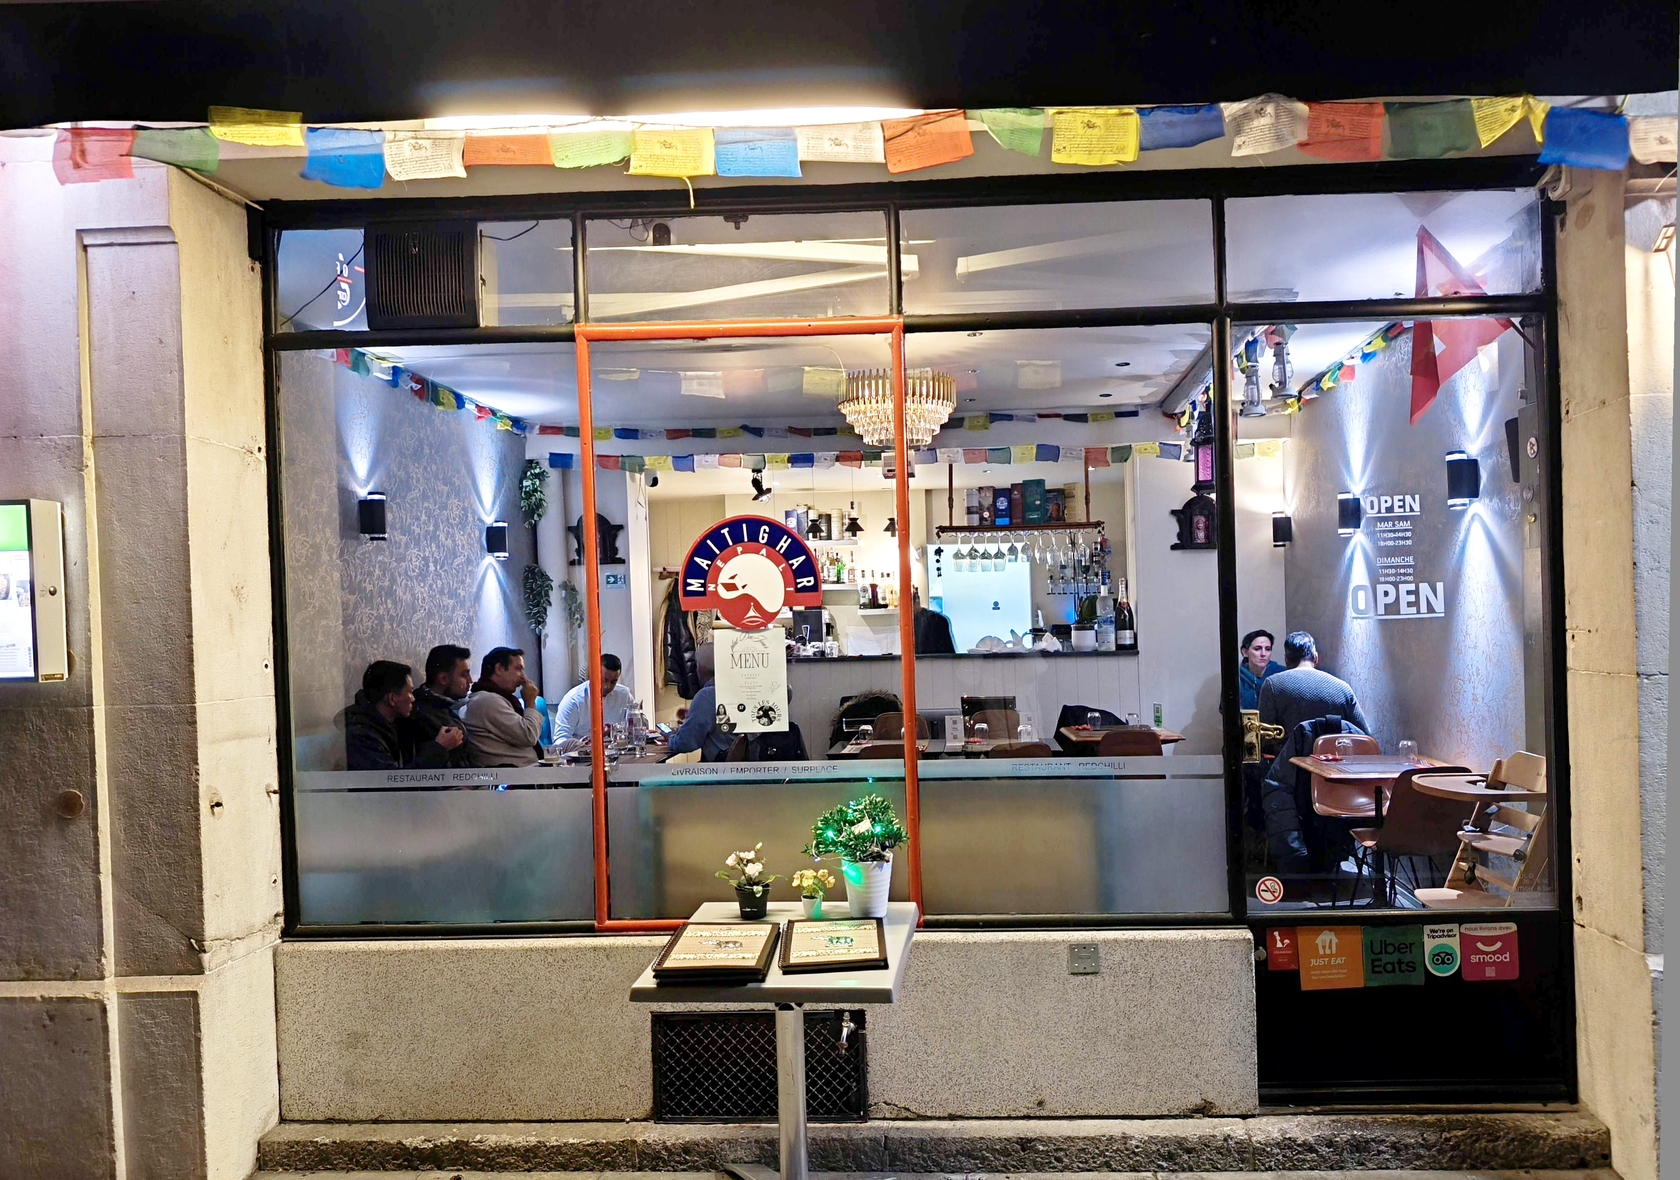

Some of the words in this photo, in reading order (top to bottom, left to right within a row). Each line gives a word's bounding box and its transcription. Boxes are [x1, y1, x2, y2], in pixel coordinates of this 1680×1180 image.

[1366, 494, 1420, 514] OPEN
[1377, 521, 1393, 529] MAR
[1394, 520, 1411, 528] SAM
[685, 523, 815, 592] MAITIGHAR
[1376, 556, 1414, 564] DIMANCHE
[707, 546, 794, 591] NEPALI
[1351, 581, 1445, 616] OPEN
[730, 652, 770, 670] MENU
[771, 702, 782, 722] JOURS
[671, 767, 719, 776] LIVRAISON
[730, 766, 779, 775] EMPORTER
[791, 765, 838, 774] SURPLACE
[1011, 762, 1071, 772] RESTAURANT
[1078, 762, 1126, 771] REDCHILLI
[387, 773, 445, 783] RESTAURANT
[452, 772, 498, 781] REDCHILLI
[1426, 932, 1457, 940] Tripadvisor
[1369, 939, 1415, 956] Uber
[1310, 958, 1329, 967] JUST
[1330, 957, 1346, 965] EAT
[1470, 951, 1510, 963] smood
[1370, 957, 1417, 976] Eats
